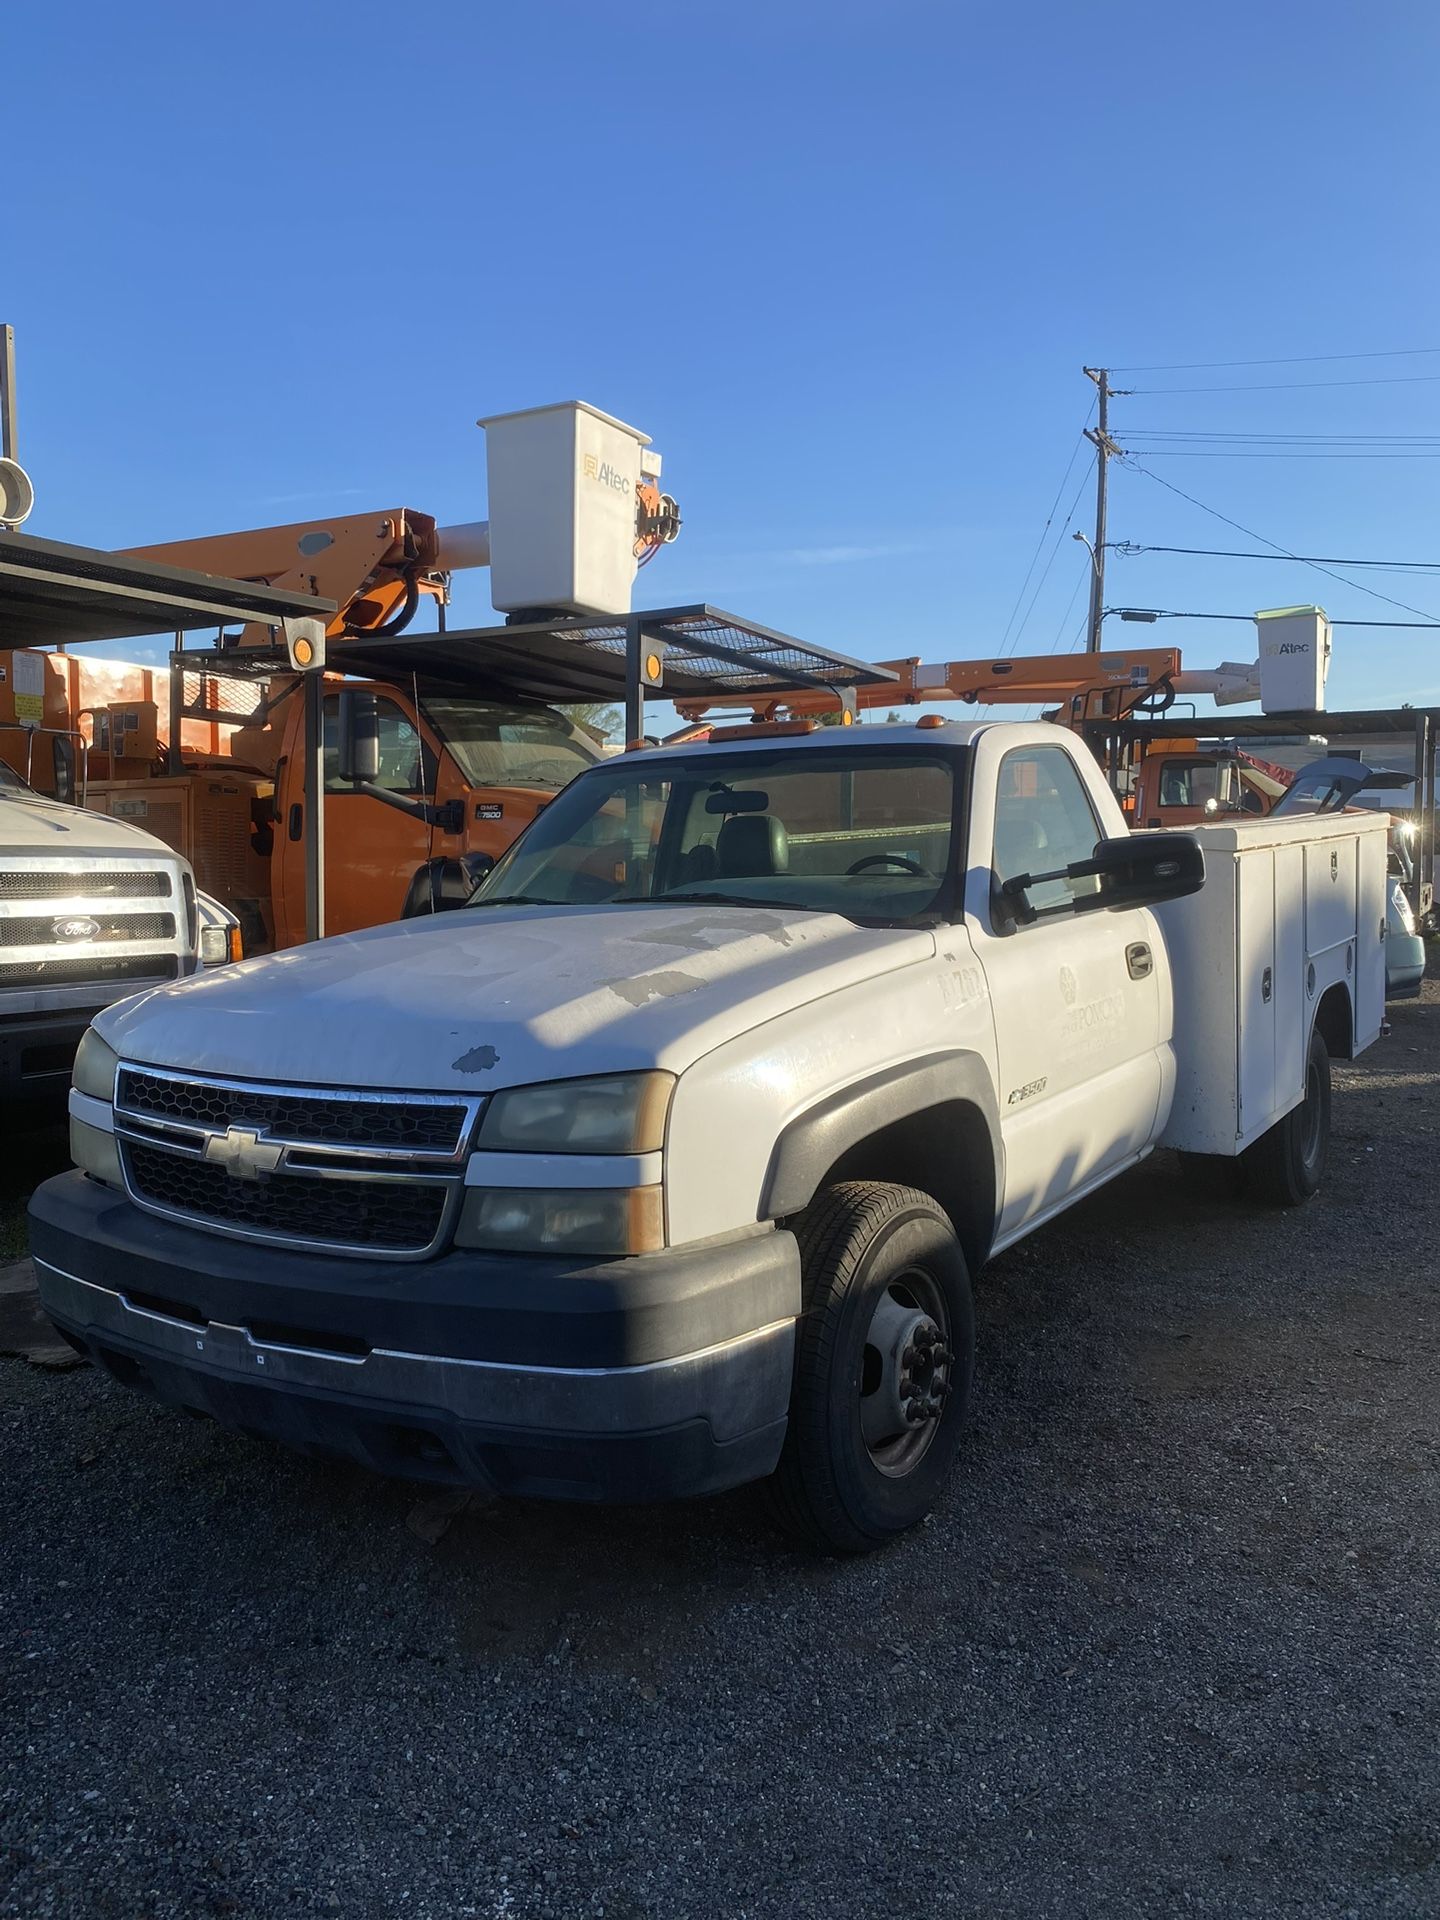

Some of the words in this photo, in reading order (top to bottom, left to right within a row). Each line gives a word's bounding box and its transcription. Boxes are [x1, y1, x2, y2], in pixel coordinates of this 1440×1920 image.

[598, 462, 630, 495] Altec
[1279, 643, 1310, 655] Altec
[64, 921, 92, 936] Ford
